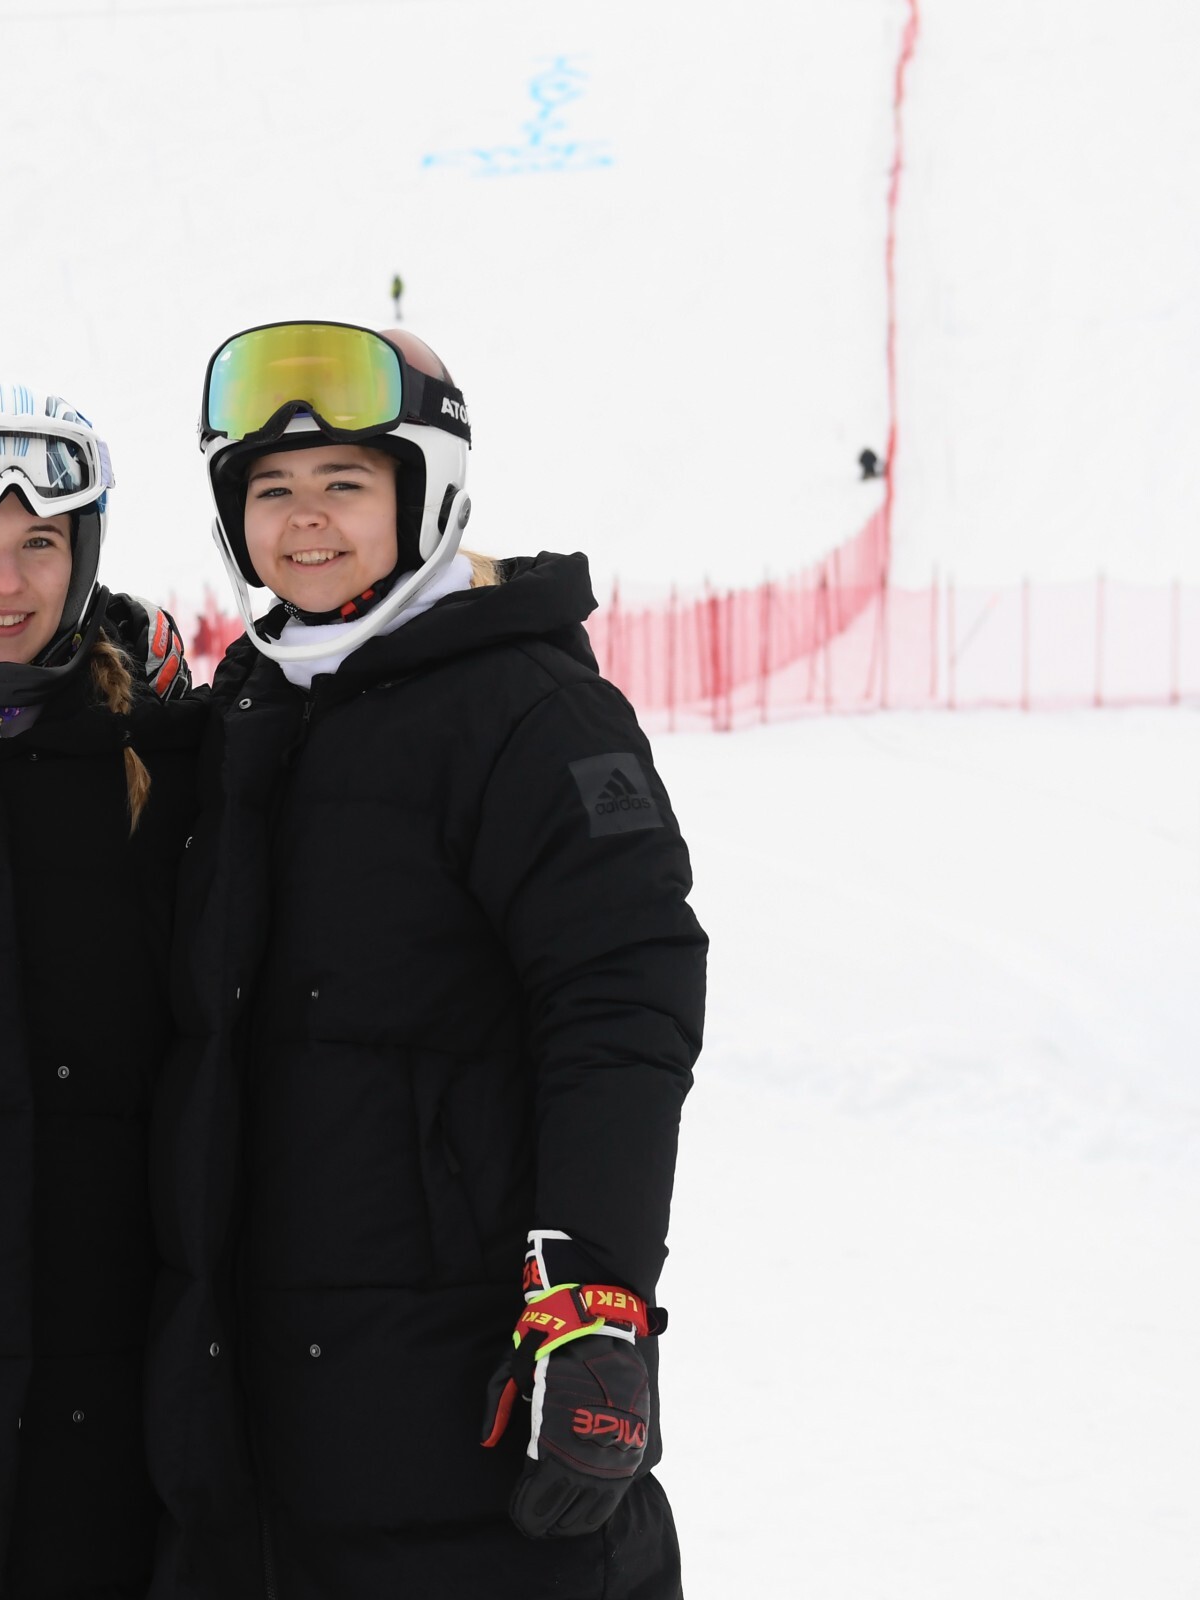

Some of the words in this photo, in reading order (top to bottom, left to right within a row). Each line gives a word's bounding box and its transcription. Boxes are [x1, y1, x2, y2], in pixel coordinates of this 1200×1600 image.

[441, 396, 471, 426] ATO
[595, 796, 651, 816] adidas
[585, 1290, 638, 1312] LEKI
[522, 1311, 566, 1330] LEKI
